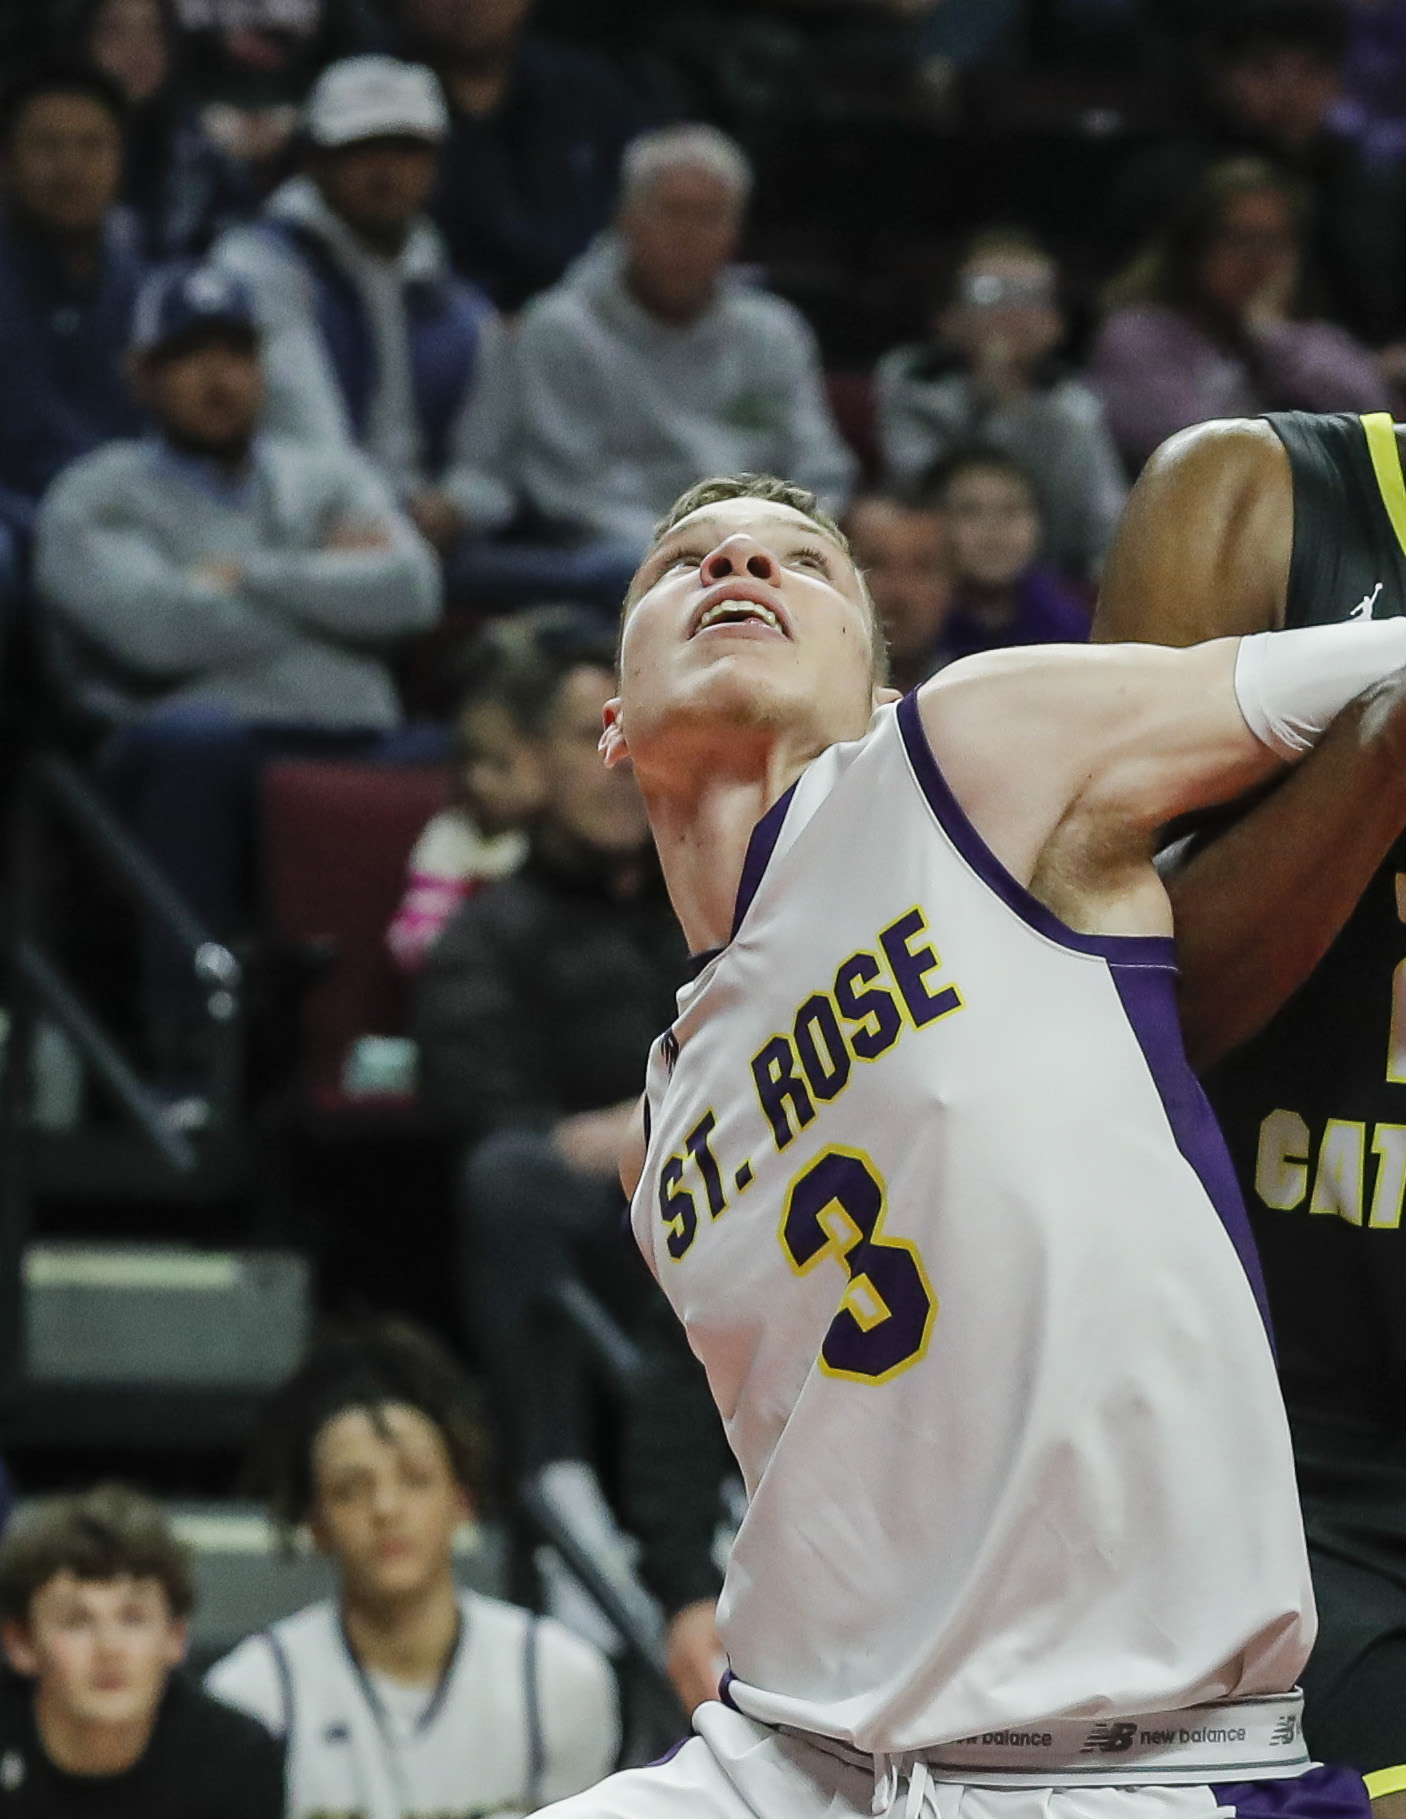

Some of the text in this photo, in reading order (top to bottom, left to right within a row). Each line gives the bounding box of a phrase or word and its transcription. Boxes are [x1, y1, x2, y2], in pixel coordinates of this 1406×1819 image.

[658, 905, 965, 1262] ST. ROSE
[777, 1143, 938, 1386] 3
[1140, 1730, 1174, 1745] new
[1179, 1727, 1246, 1744] balance
